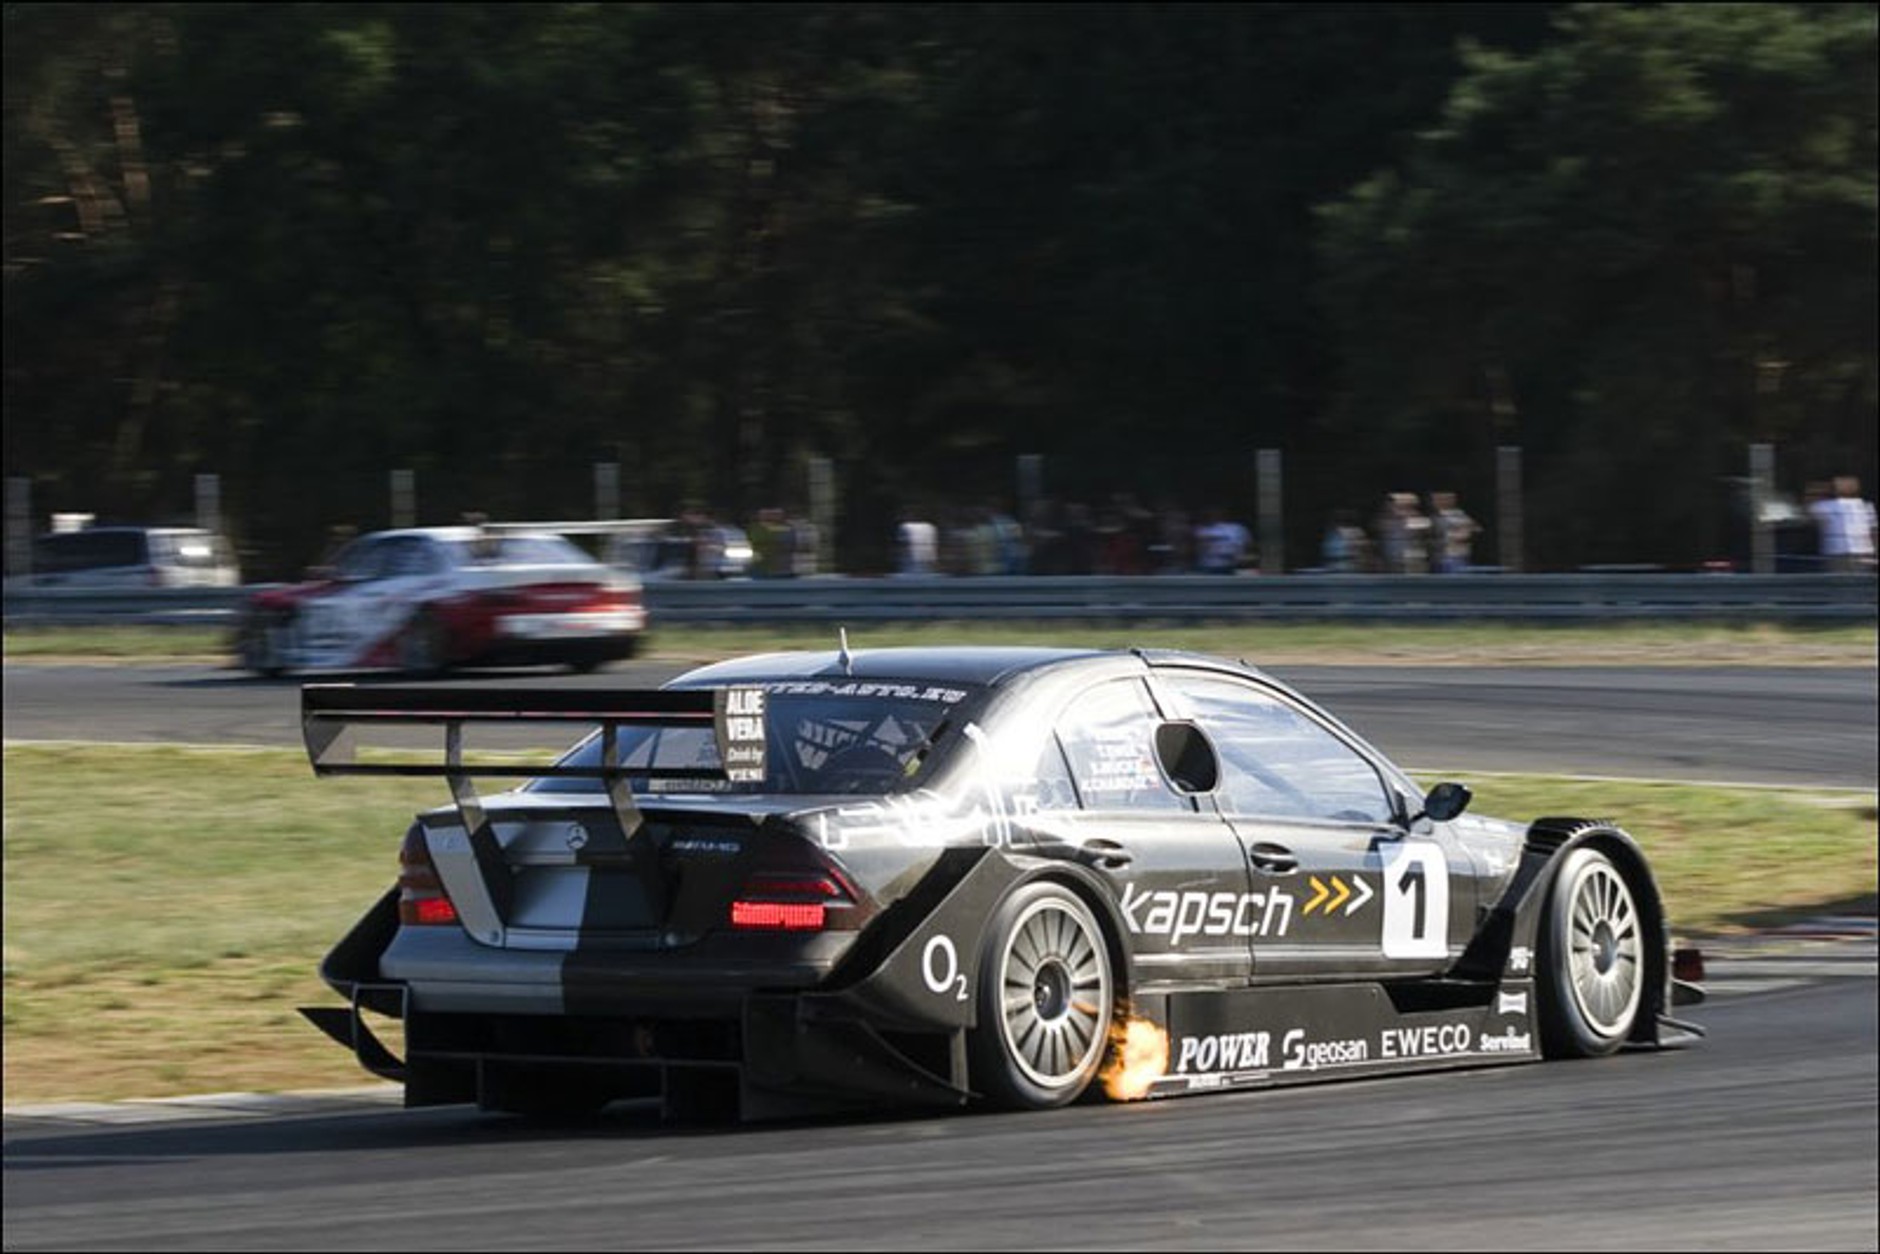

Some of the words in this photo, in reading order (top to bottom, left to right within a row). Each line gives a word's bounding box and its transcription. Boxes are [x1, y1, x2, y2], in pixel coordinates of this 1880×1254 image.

[727, 690, 764, 715] ALOE
[727, 717, 764, 741] VERA
[1119, 883, 1293, 945] kapsch
[1398, 861, 1426, 939] 1
[1177, 1031, 1271, 1072] POWER
[1381, 1023, 1470, 1058] EWECO
